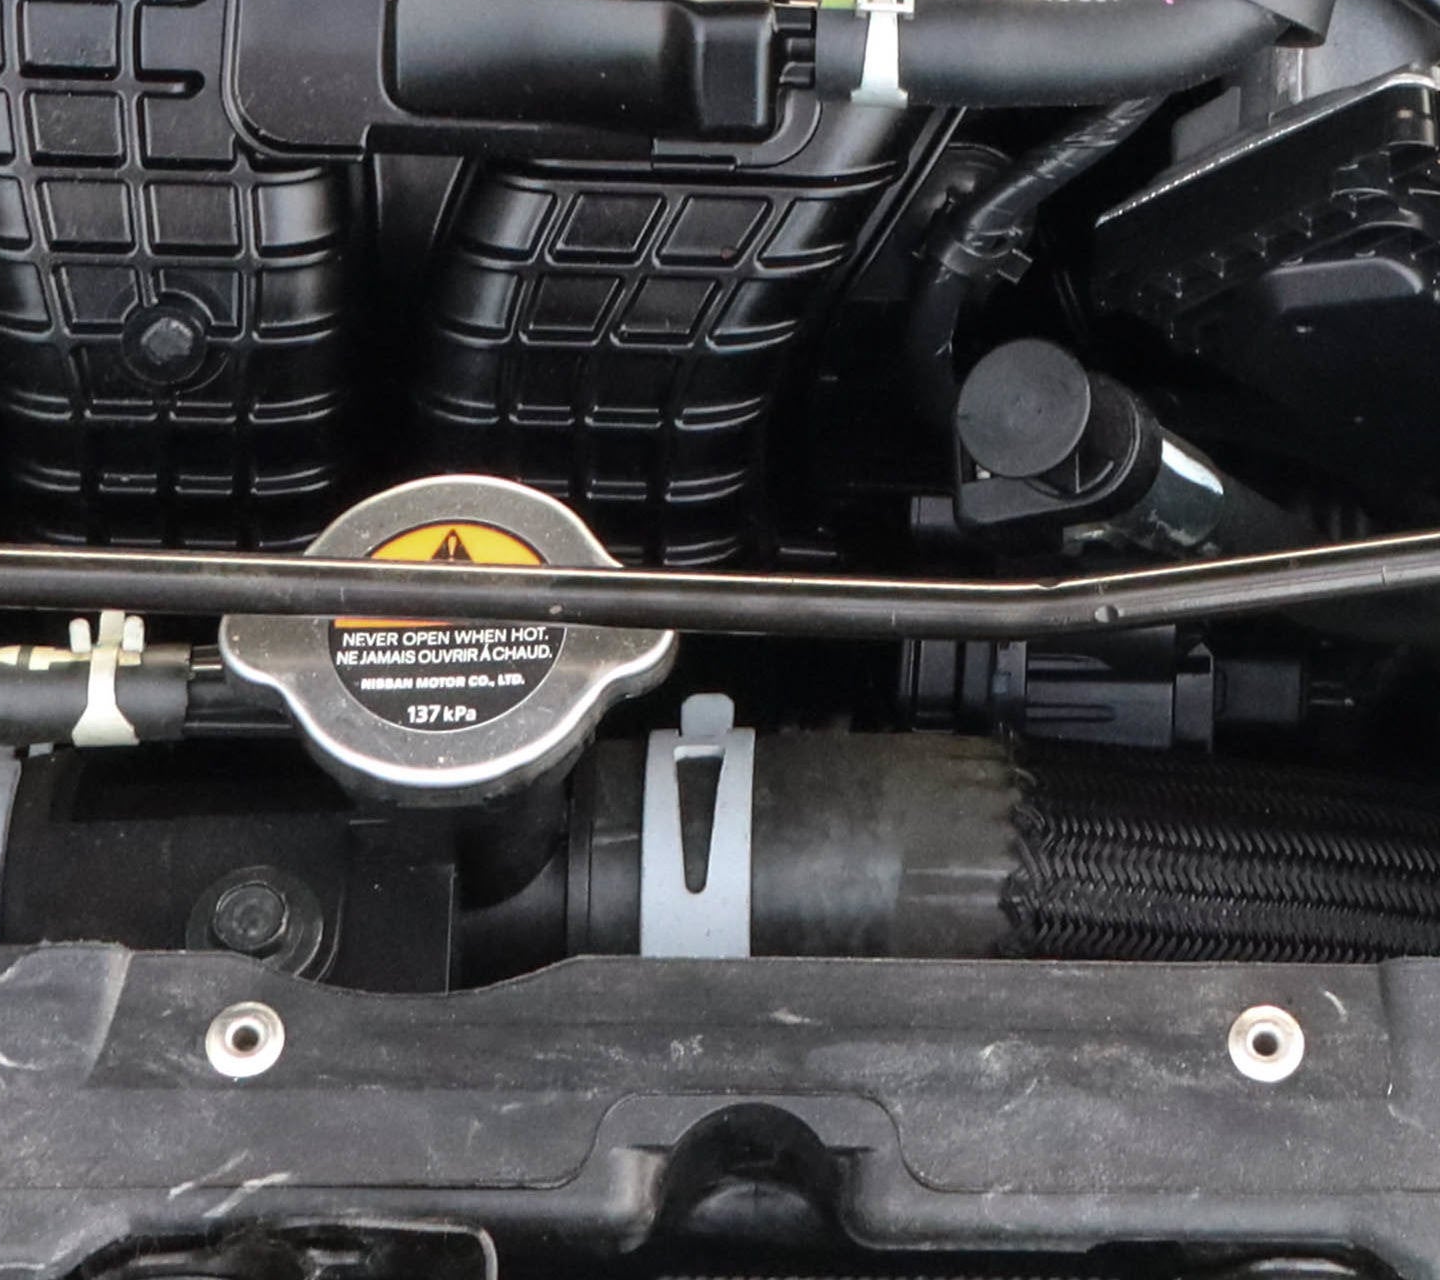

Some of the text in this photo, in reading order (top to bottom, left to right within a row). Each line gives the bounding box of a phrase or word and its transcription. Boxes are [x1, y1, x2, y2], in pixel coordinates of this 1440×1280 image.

[342, 627, 550, 647] NEVER OPEN WHEN HOT.
[336, 649, 359, 665] NE
[361, 648, 416, 665] JAMAIS
[418, 647, 477, 663] OUVRIR
[493, 645, 552, 661] CHAUD.
[361, 673, 525, 689] NISSAN MOTOR CO., LTD.
[408, 703, 477, 723] 137 kPa
